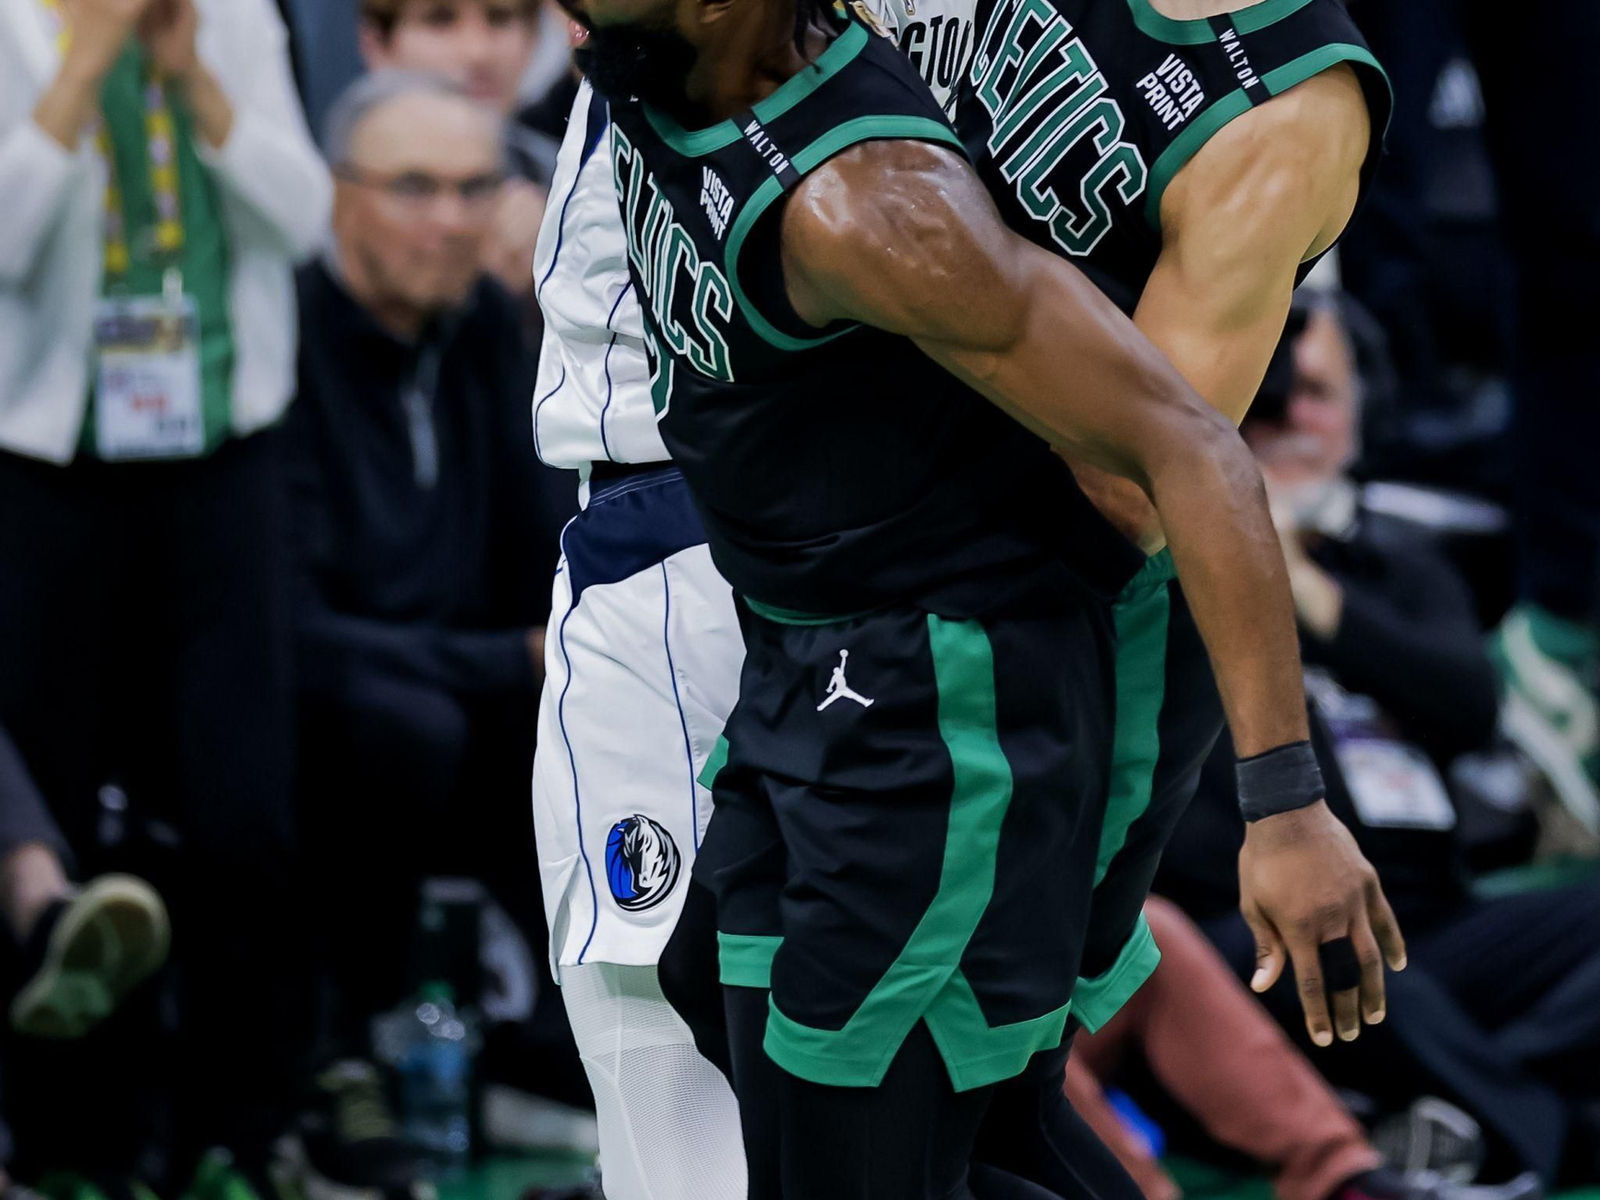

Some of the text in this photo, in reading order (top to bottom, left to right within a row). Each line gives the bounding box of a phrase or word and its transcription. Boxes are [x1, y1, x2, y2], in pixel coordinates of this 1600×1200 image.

[1155, 53, 1205, 118] VISTA
[1219, 28, 1260, 89] WALTON
[1135, 72, 1185, 131] PRINT
[744, 119, 789, 174] WALTON
[702, 165, 734, 225] VISTA
